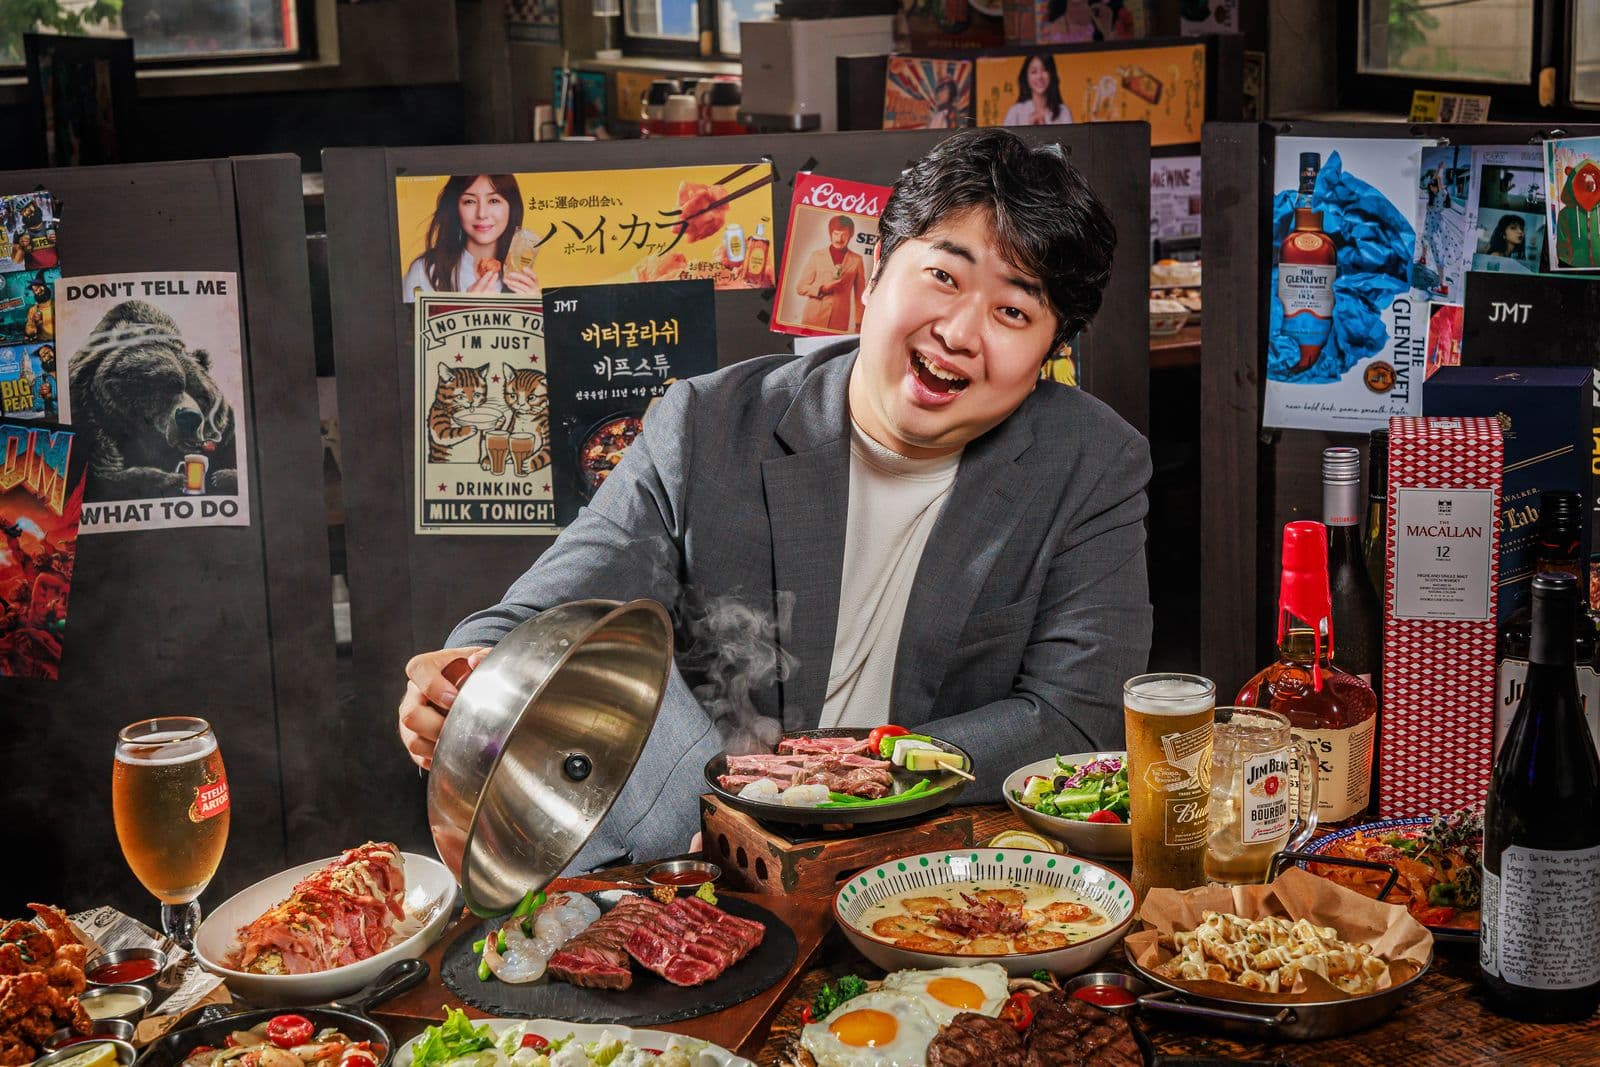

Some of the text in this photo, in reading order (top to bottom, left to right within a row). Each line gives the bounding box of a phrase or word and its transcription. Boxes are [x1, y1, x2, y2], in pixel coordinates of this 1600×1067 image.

[811, 182, 880, 216] Coors
[564, 242, 597, 255] ボール
[1285, 274, 1327, 285] GLENLIVET
[66, 279, 227, 301] DON'T TELL ME
[553, 299, 578, 313] JMT
[1488, 302, 1532, 324] JMT
[435, 313, 545, 333] NO THANK YO
[461, 334, 530, 350] I'M JUST
[581, 318, 679, 349] 버터굴라쉬
[1412, 337, 1425, 367] THE
[593, 353, 671, 381] 비프스튜
[1, 378, 31, 399] BIG
[4, 395, 34, 412] PEAT
[456, 481, 533, 496] DRINKING
[79, 499, 238, 526] WHAT TO DO
[429, 503, 471, 521] MILK
[1406, 525, 1482, 538] MACALLAN
[1436, 546, 1450, 558] 12
[1247, 763, 1268, 785] JIM
[1251, 802, 1287, 821] BOURBON
